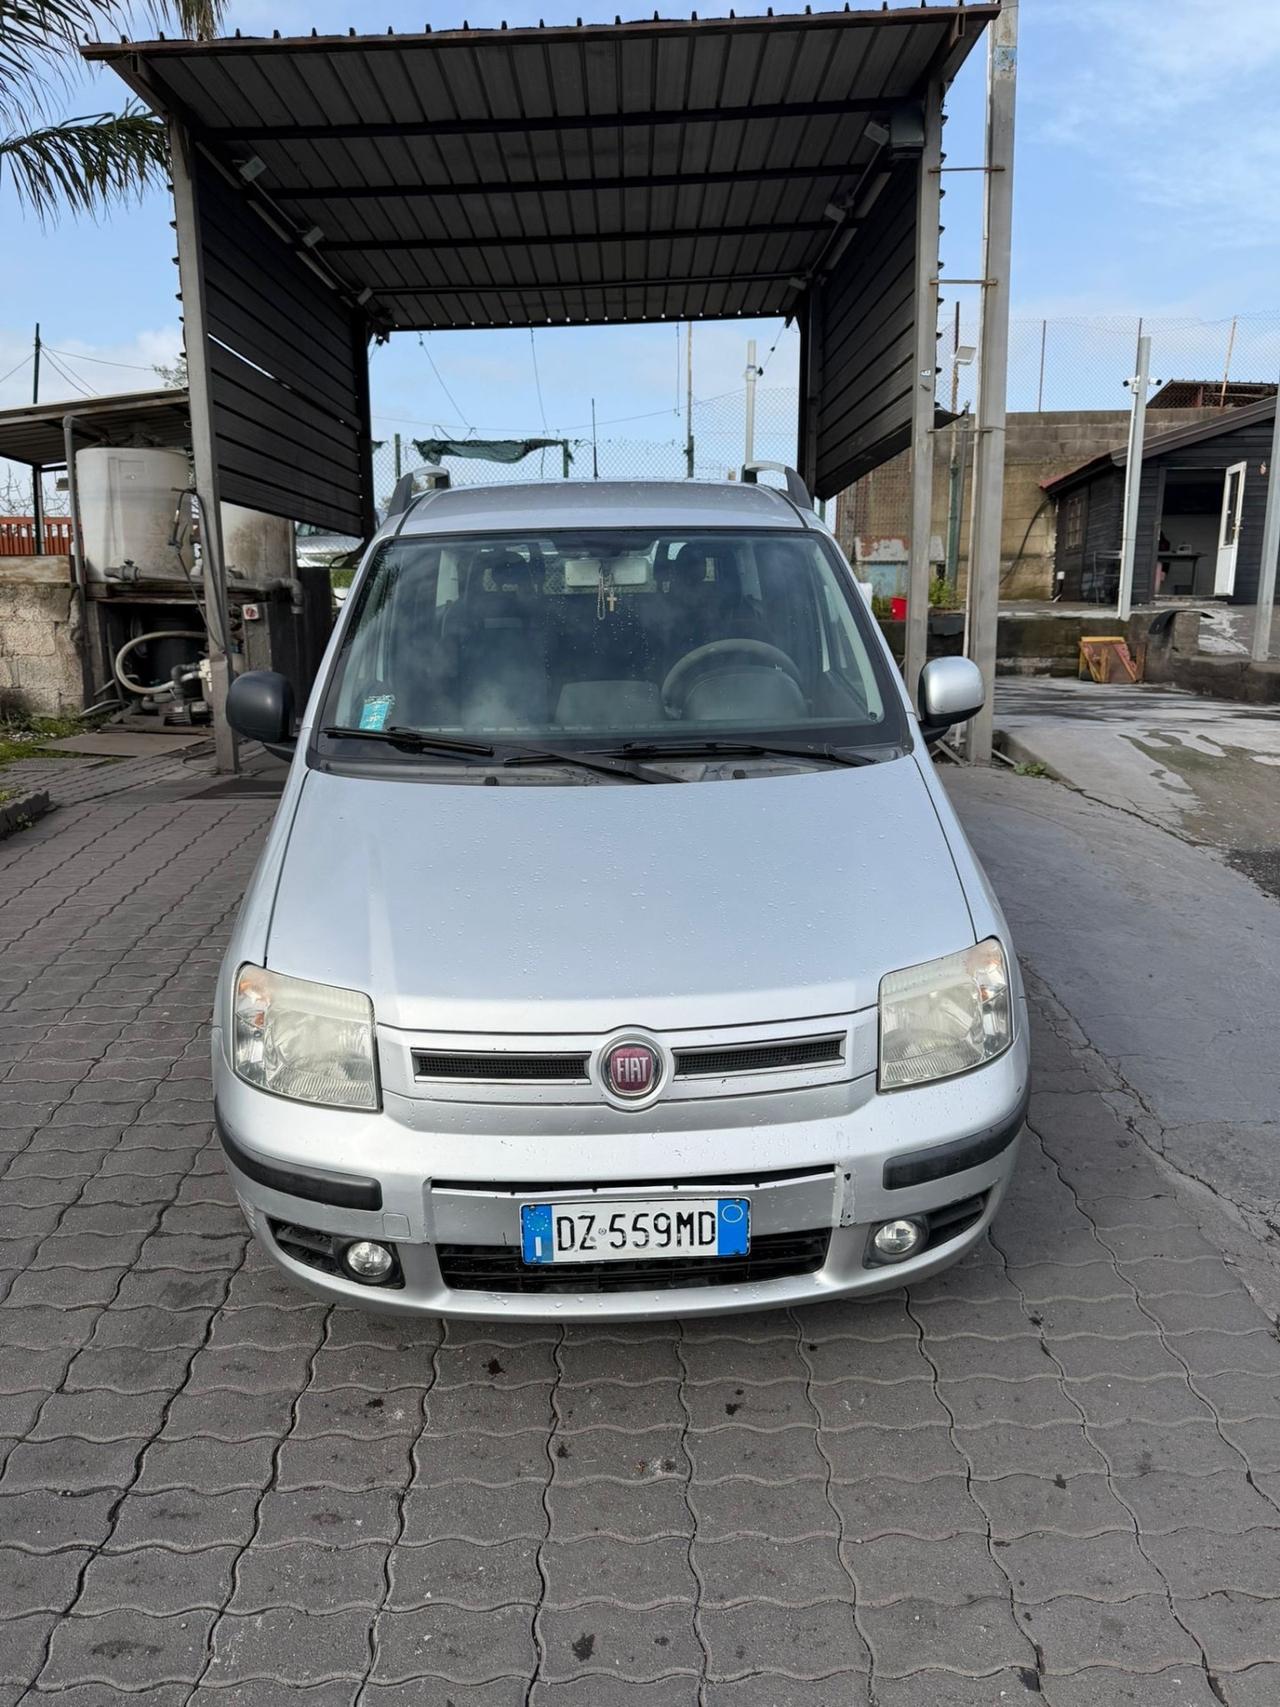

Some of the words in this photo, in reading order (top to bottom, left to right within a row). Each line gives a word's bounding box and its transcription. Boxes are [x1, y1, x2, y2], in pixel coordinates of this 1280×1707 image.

[616, 1057, 648, 1082] FIAT
[556, 1214, 597, 1251] DZ
[608, 1211, 716, 1249] 559MD
